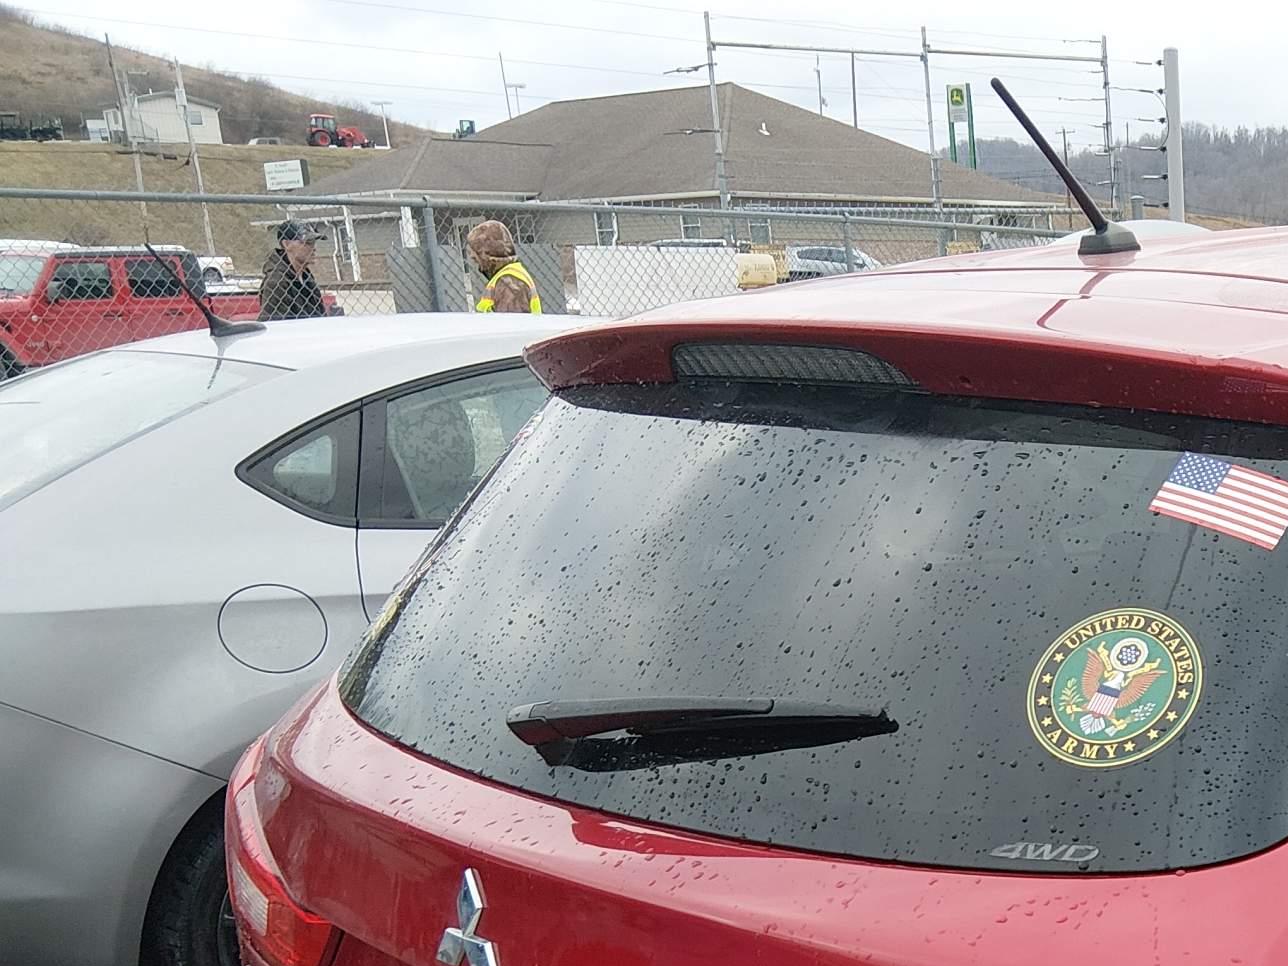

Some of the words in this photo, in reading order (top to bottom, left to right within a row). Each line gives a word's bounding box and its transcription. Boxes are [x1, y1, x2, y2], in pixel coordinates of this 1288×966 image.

[1064, 615, 1146, 649] UNITED
[1147, 620, 1195, 684] STATES
[1047, 728, 1118, 759] ARMY
[990, 843, 1100, 862] 4WD
